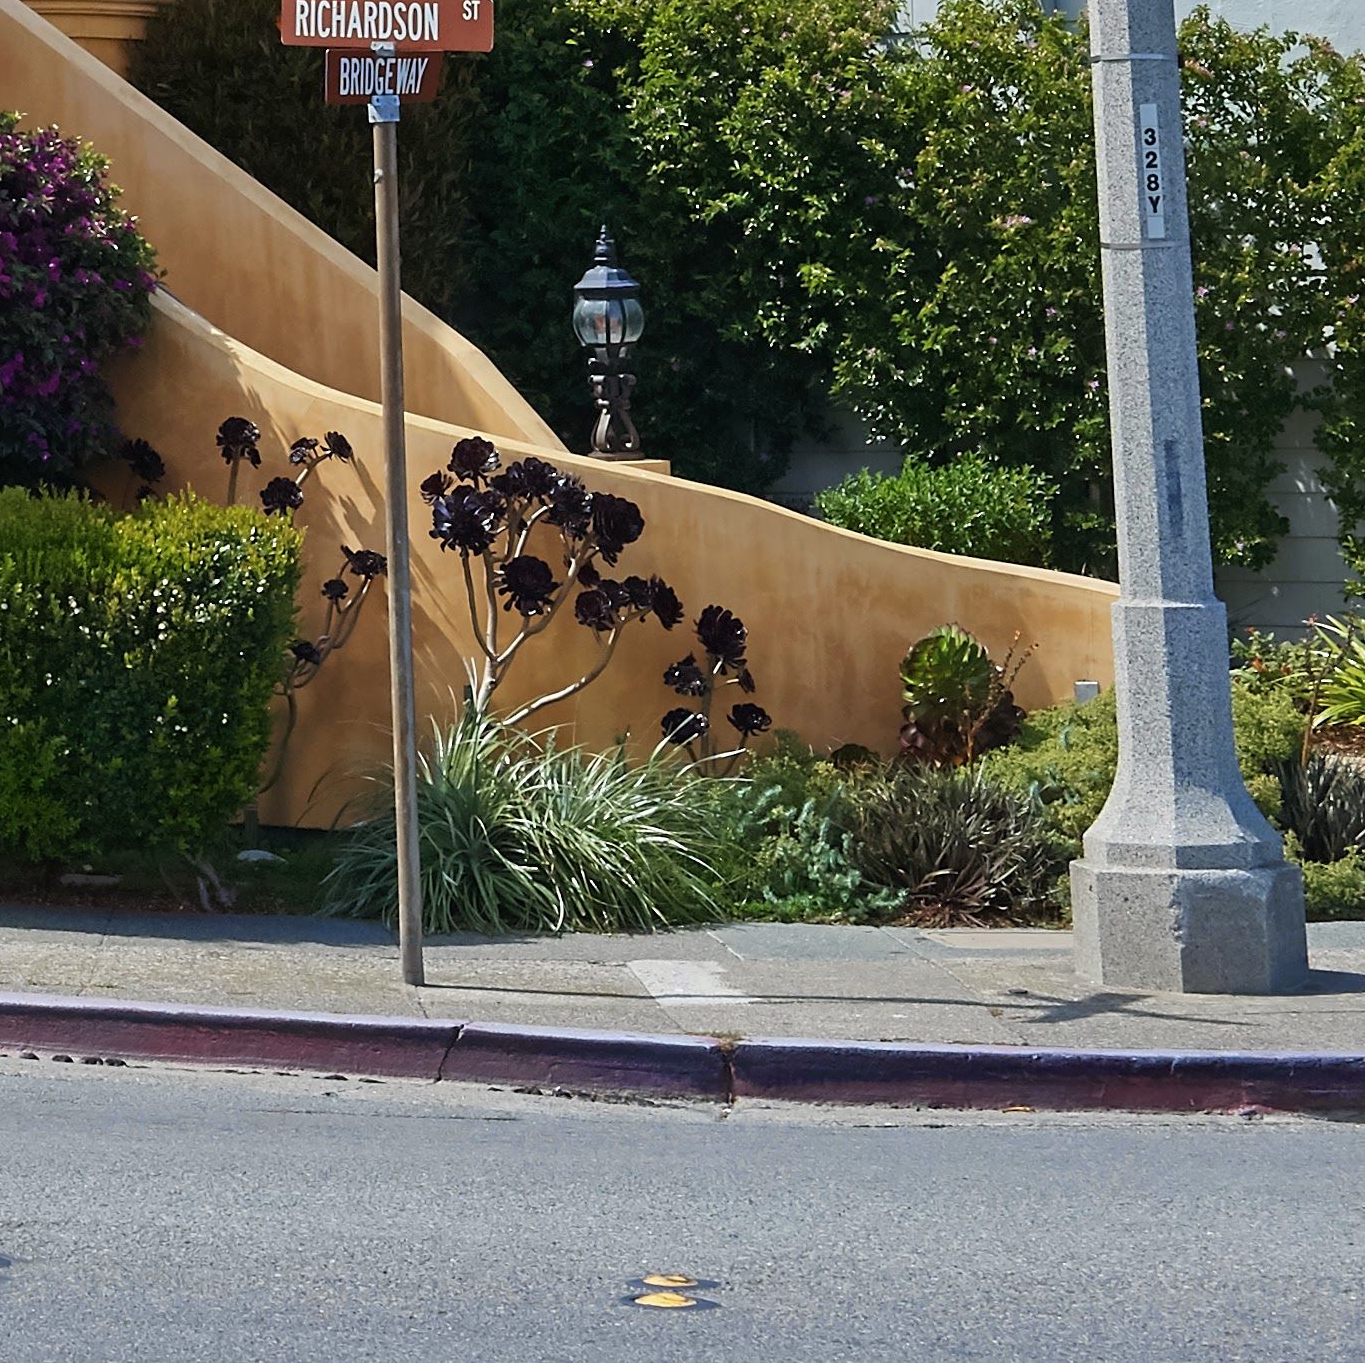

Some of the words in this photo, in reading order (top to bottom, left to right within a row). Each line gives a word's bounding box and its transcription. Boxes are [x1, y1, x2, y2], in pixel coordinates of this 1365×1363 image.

[295, 0, 439, 41] RICHARDSON
[462, 0, 481, 21] ST
[340, 57, 429, 96] BRIDGEWAY
[1144, 127, 1161, 214] 328Y
